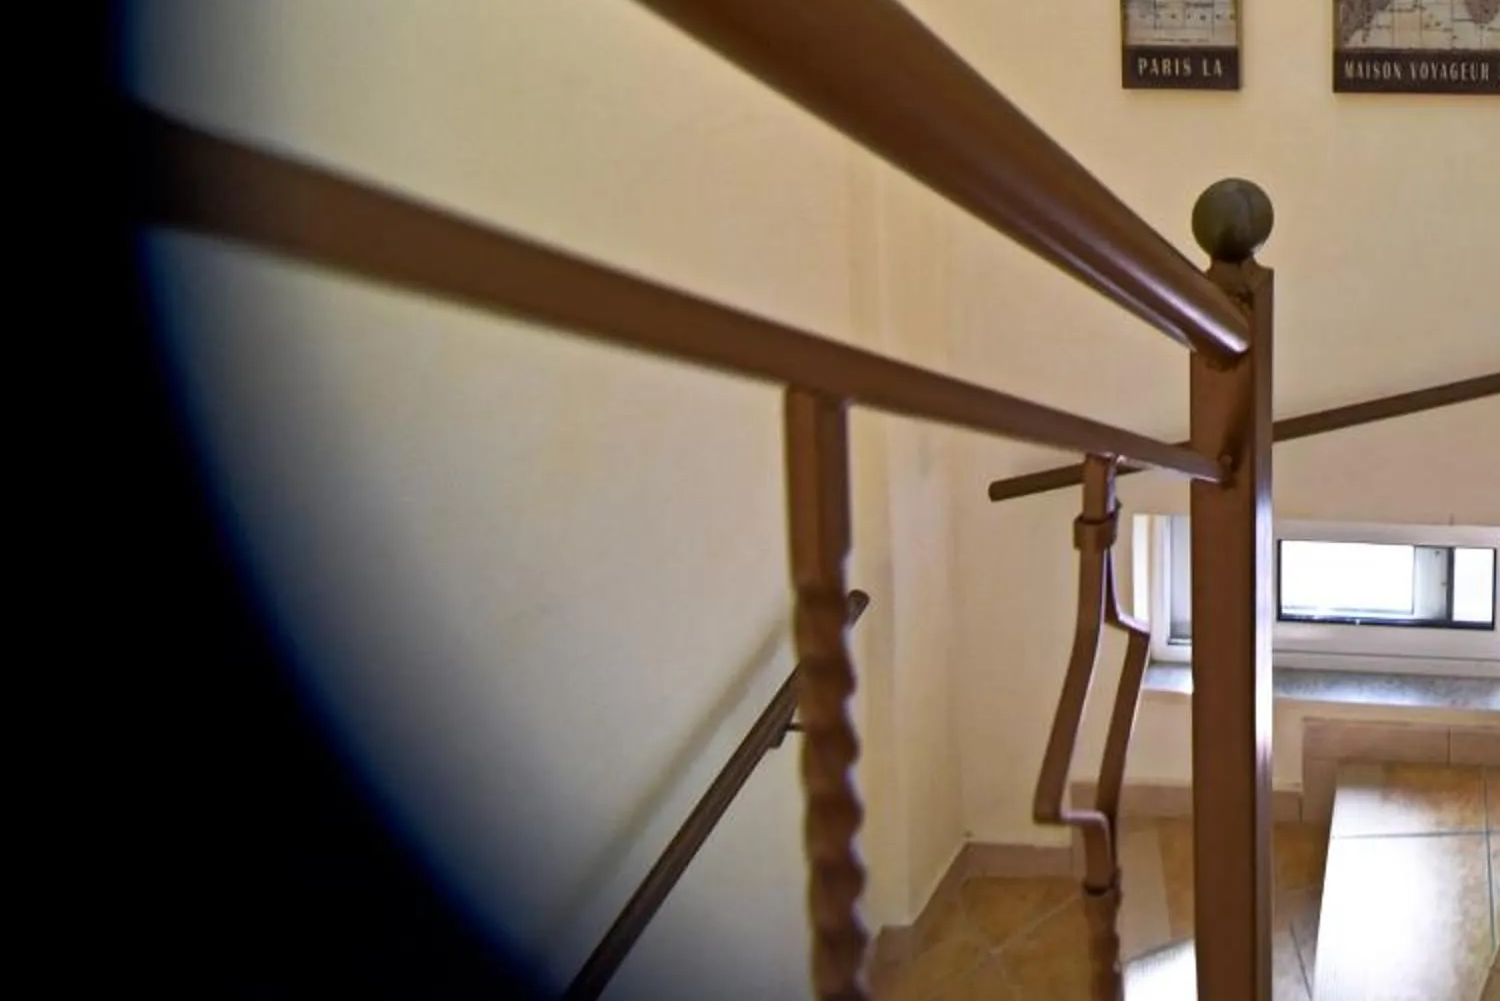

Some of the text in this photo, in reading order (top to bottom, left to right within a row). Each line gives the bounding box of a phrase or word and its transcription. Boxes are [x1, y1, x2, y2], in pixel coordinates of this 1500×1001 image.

[1138, 58, 1222, 77] PARIS LA
[1344, 61, 1402, 80] MAISON
[1409, 61, 1490, 82] VOYAGEUR
